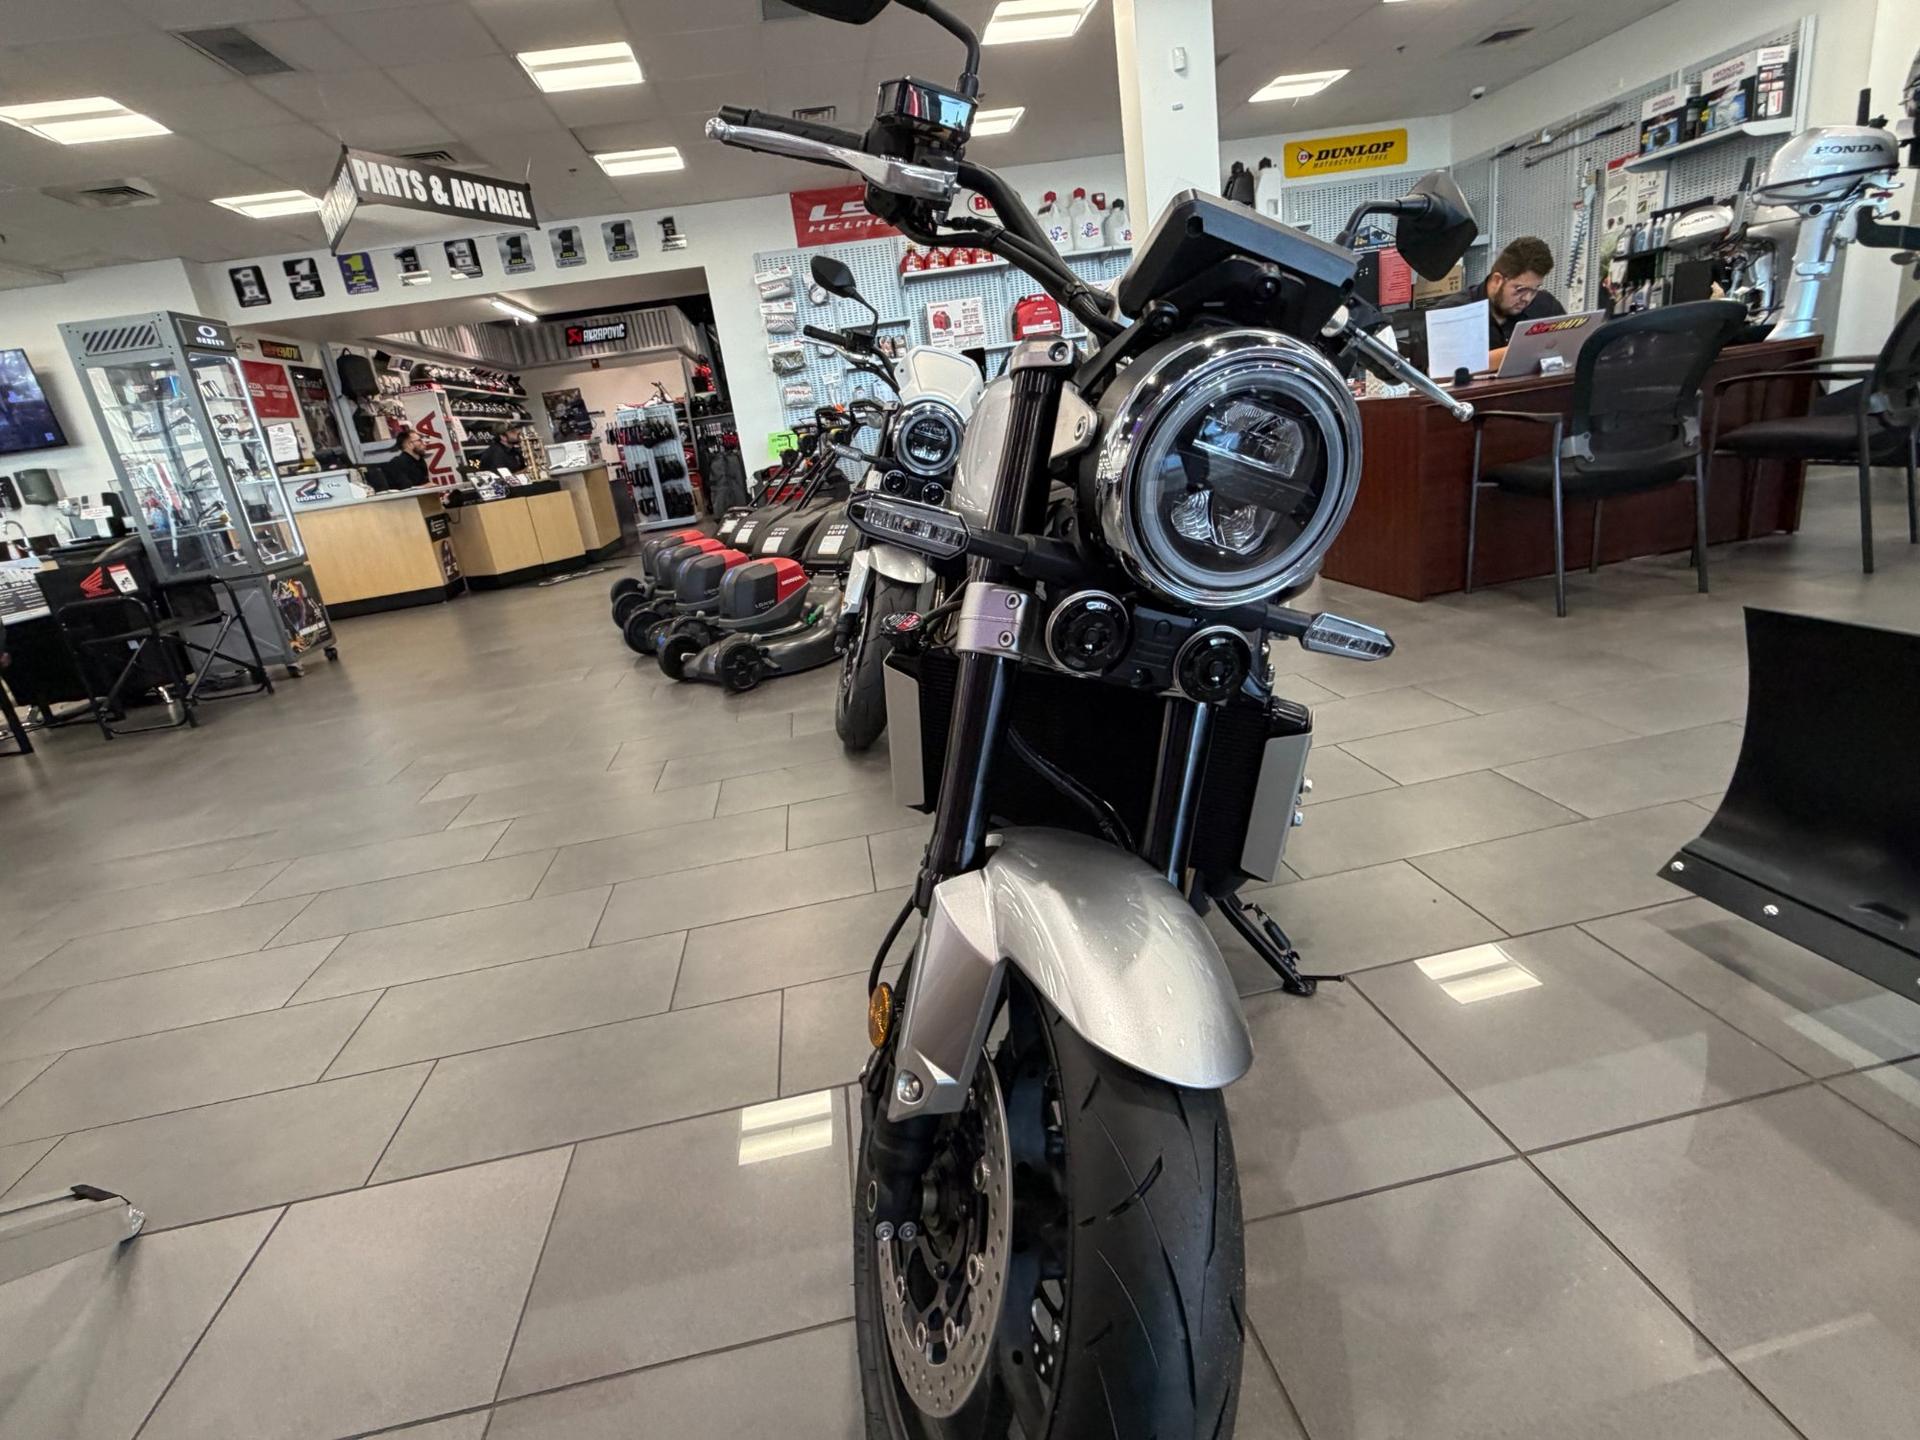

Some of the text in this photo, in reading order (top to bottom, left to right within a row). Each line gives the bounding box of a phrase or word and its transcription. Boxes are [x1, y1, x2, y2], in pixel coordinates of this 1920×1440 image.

[1315, 141, 1395, 160] DUNLOP
[1814, 144, 1884, 154] HONDA
[351, 158, 532, 220] PARTS & APPAREL
[809, 200, 871, 221] LS
[808, 218, 887, 233] HELME
[416, 411, 456, 485] ENA
[296, 493, 333, 503] HONDA
